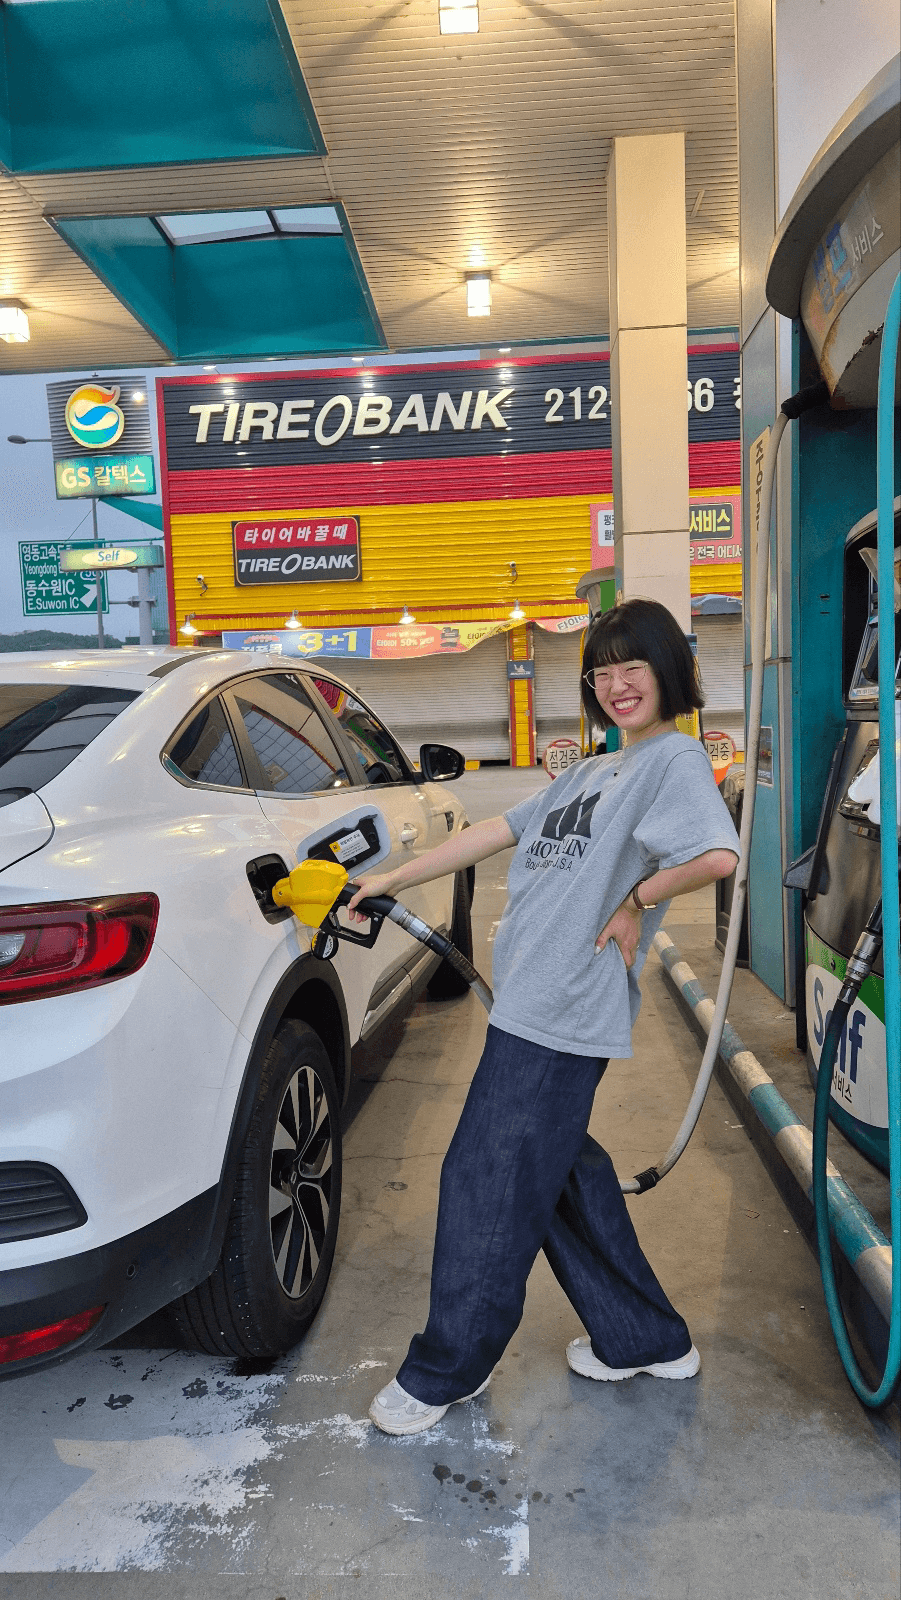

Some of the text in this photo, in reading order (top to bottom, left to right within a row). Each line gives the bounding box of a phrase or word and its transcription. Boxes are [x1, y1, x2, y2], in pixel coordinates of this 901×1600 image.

[852, 216, 884, 265] 서비스
[188, 388, 515, 446] TIREOBANK
[61, 464, 146, 489] GS 칼텍스
[690, 508, 731, 533] 서비스
[22, 544, 71, 561] 영동고속
[97, 550, 120, 562] Self
[23, 562, 57, 577] Yeongdong
[238, 553, 356, 575] TIREOBANK
[25, 578, 75, 597] 동수원IC
[27, 596, 80, 610] E.Suwon IC
[297, 630, 357, 653] 3+1
